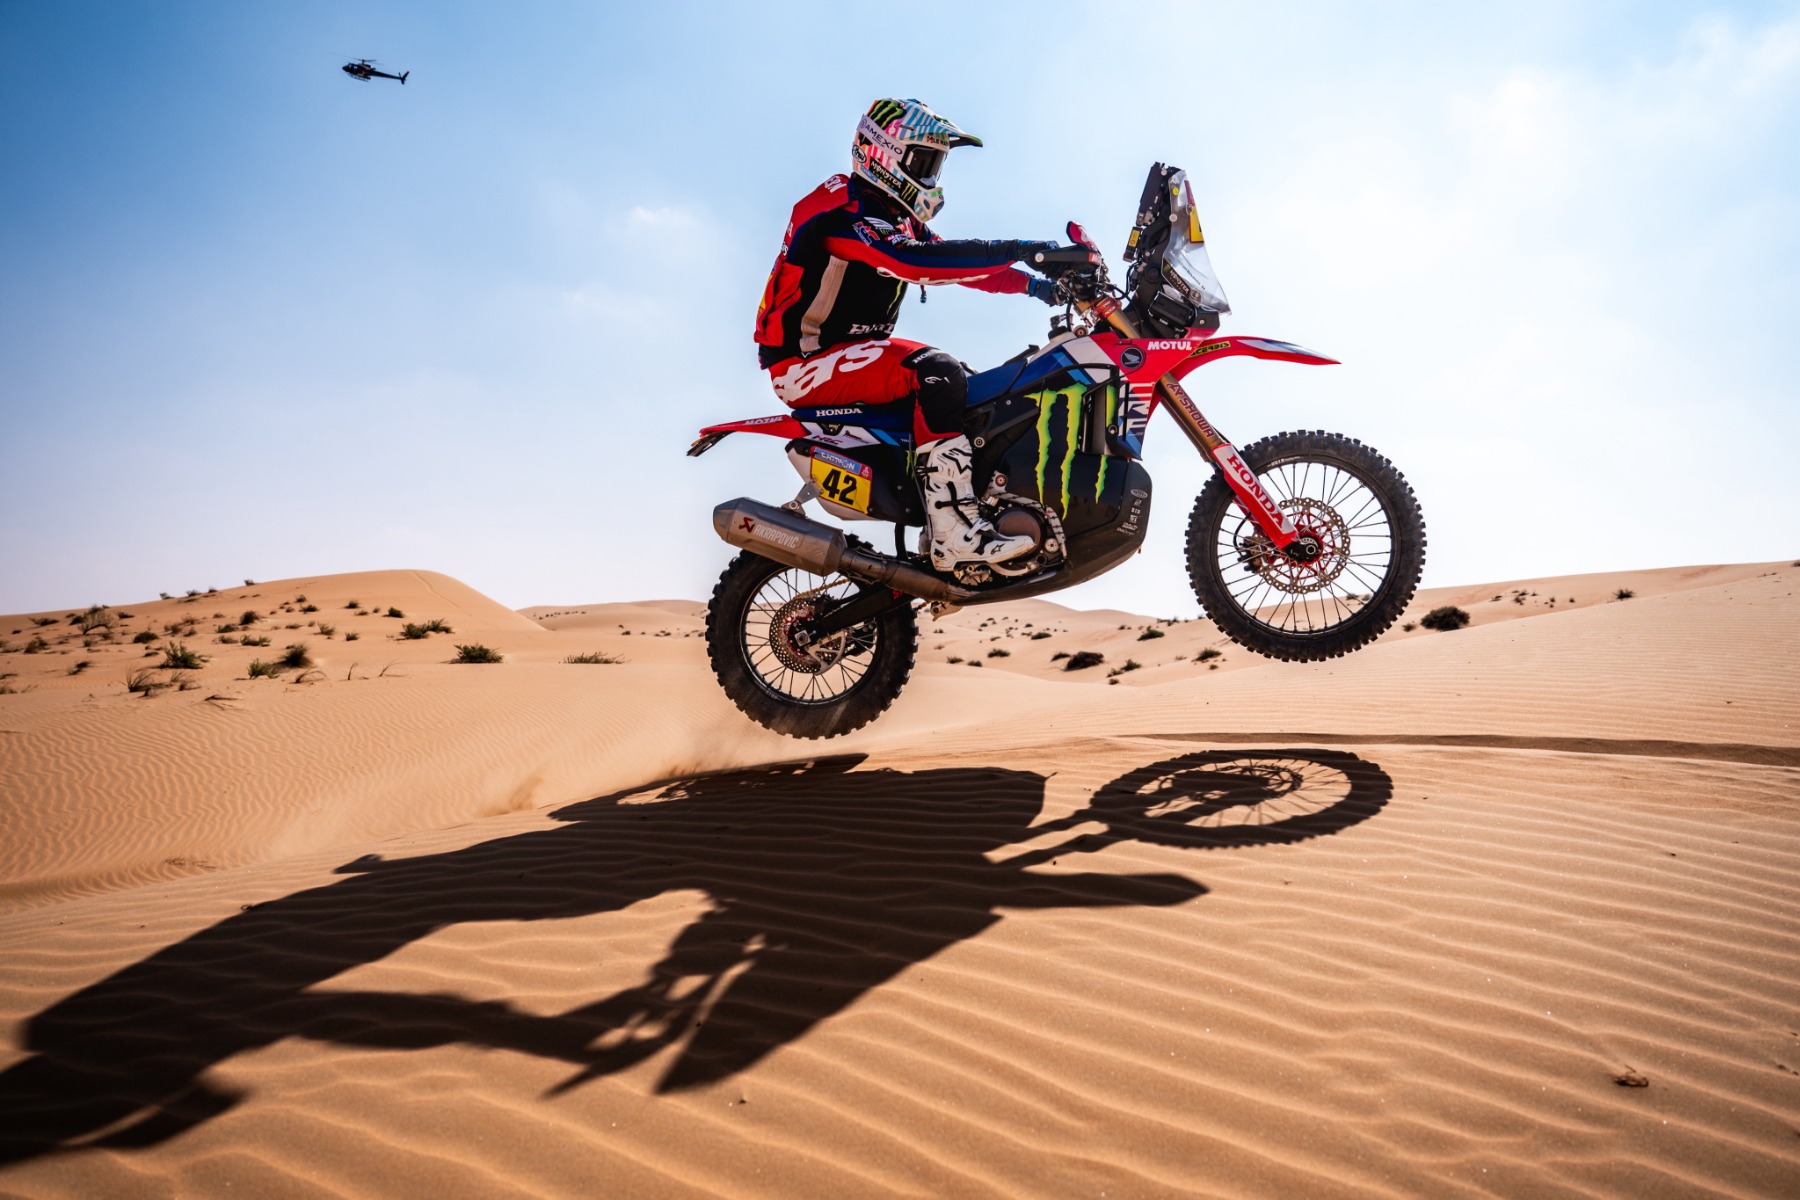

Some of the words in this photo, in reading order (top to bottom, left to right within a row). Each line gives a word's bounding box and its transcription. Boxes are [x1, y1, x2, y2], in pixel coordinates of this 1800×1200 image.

[865, 124, 903, 155] AMEXIO
[870, 160, 902, 188] MONSTER
[1147, 341, 1192, 350] MOTUL
[744, 415, 784, 425] MOTUL
[815, 407, 863, 417] HONDA
[1180, 397, 1215, 438] SHOWA
[822, 468, 857, 505] 42
[1227, 453, 1284, 528] HONDA
